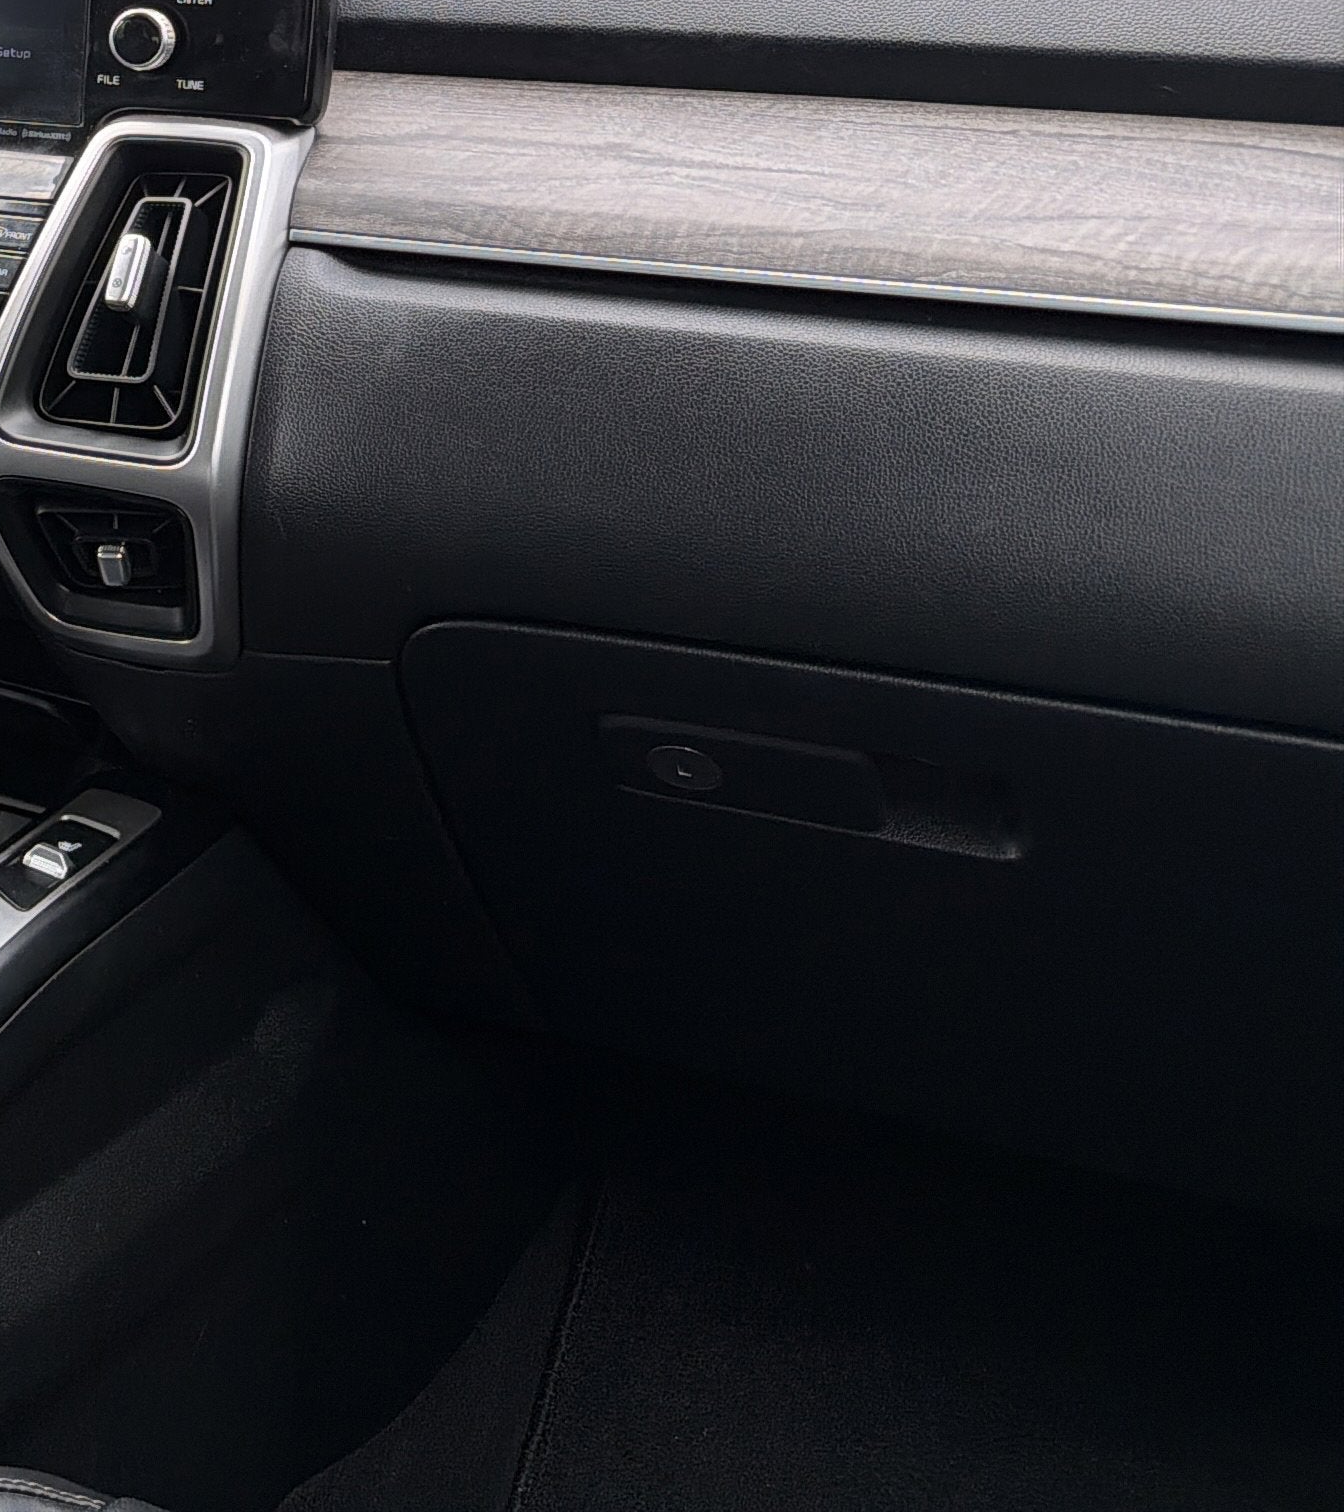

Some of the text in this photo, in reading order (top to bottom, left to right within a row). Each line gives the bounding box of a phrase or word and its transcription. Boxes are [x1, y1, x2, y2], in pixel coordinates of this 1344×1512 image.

[97, 74, 120, 85] FILE
[176, 80, 204, 91] TUNE
[5, 230, 33, 242] FRONT
